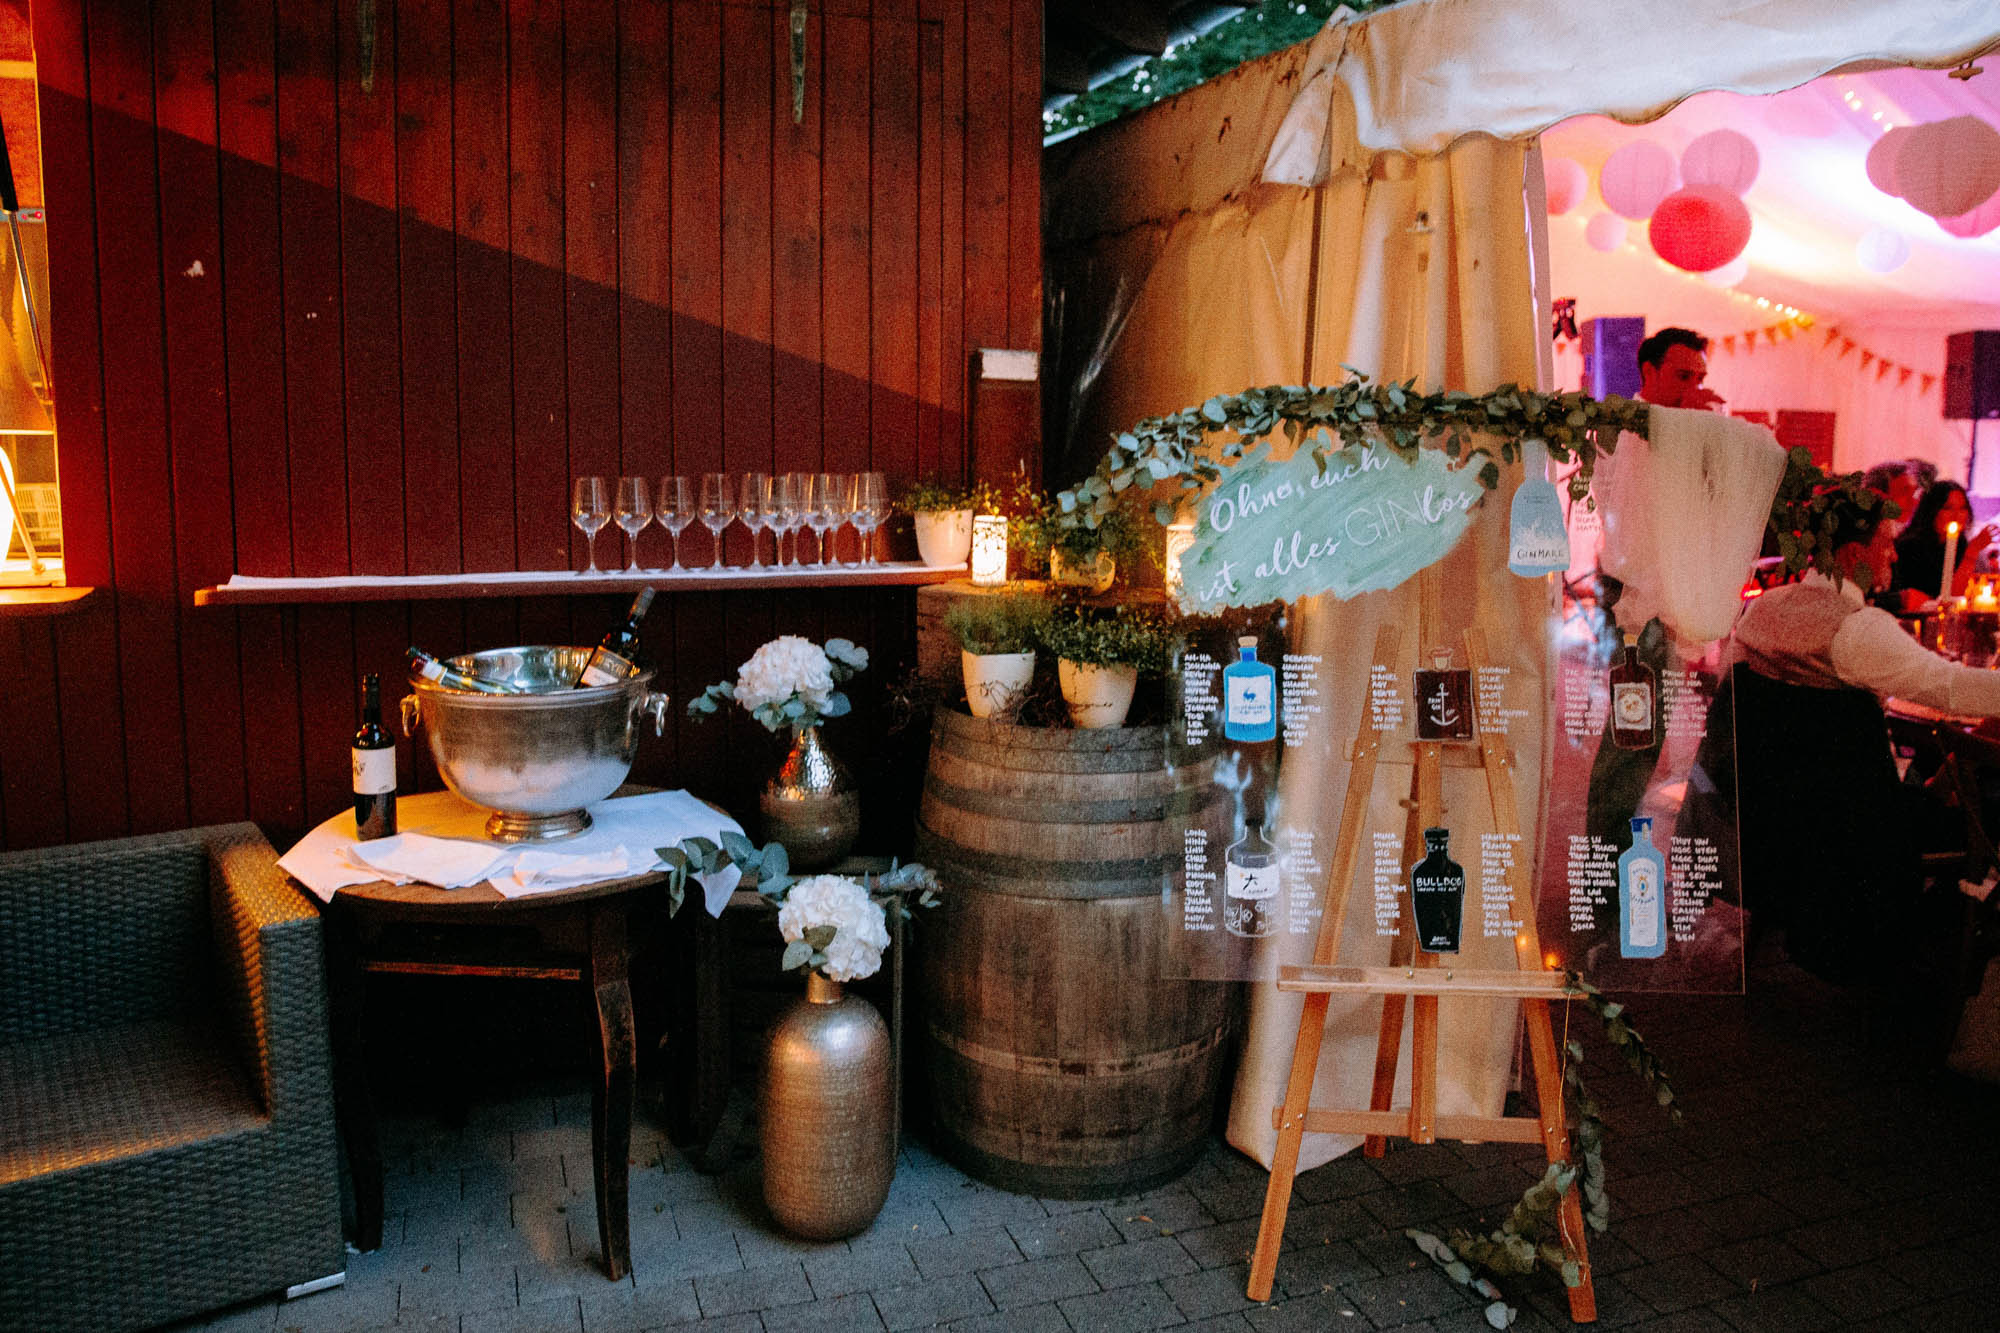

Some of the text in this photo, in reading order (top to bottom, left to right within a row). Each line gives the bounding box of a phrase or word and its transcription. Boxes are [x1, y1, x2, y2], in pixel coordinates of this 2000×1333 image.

[1310, 446, 1391, 491] euch
[1199, 560, 1238, 602] ist
[1253, 531, 1342, 579] alles
[1416, 876, 1463, 888] BULLDOG
